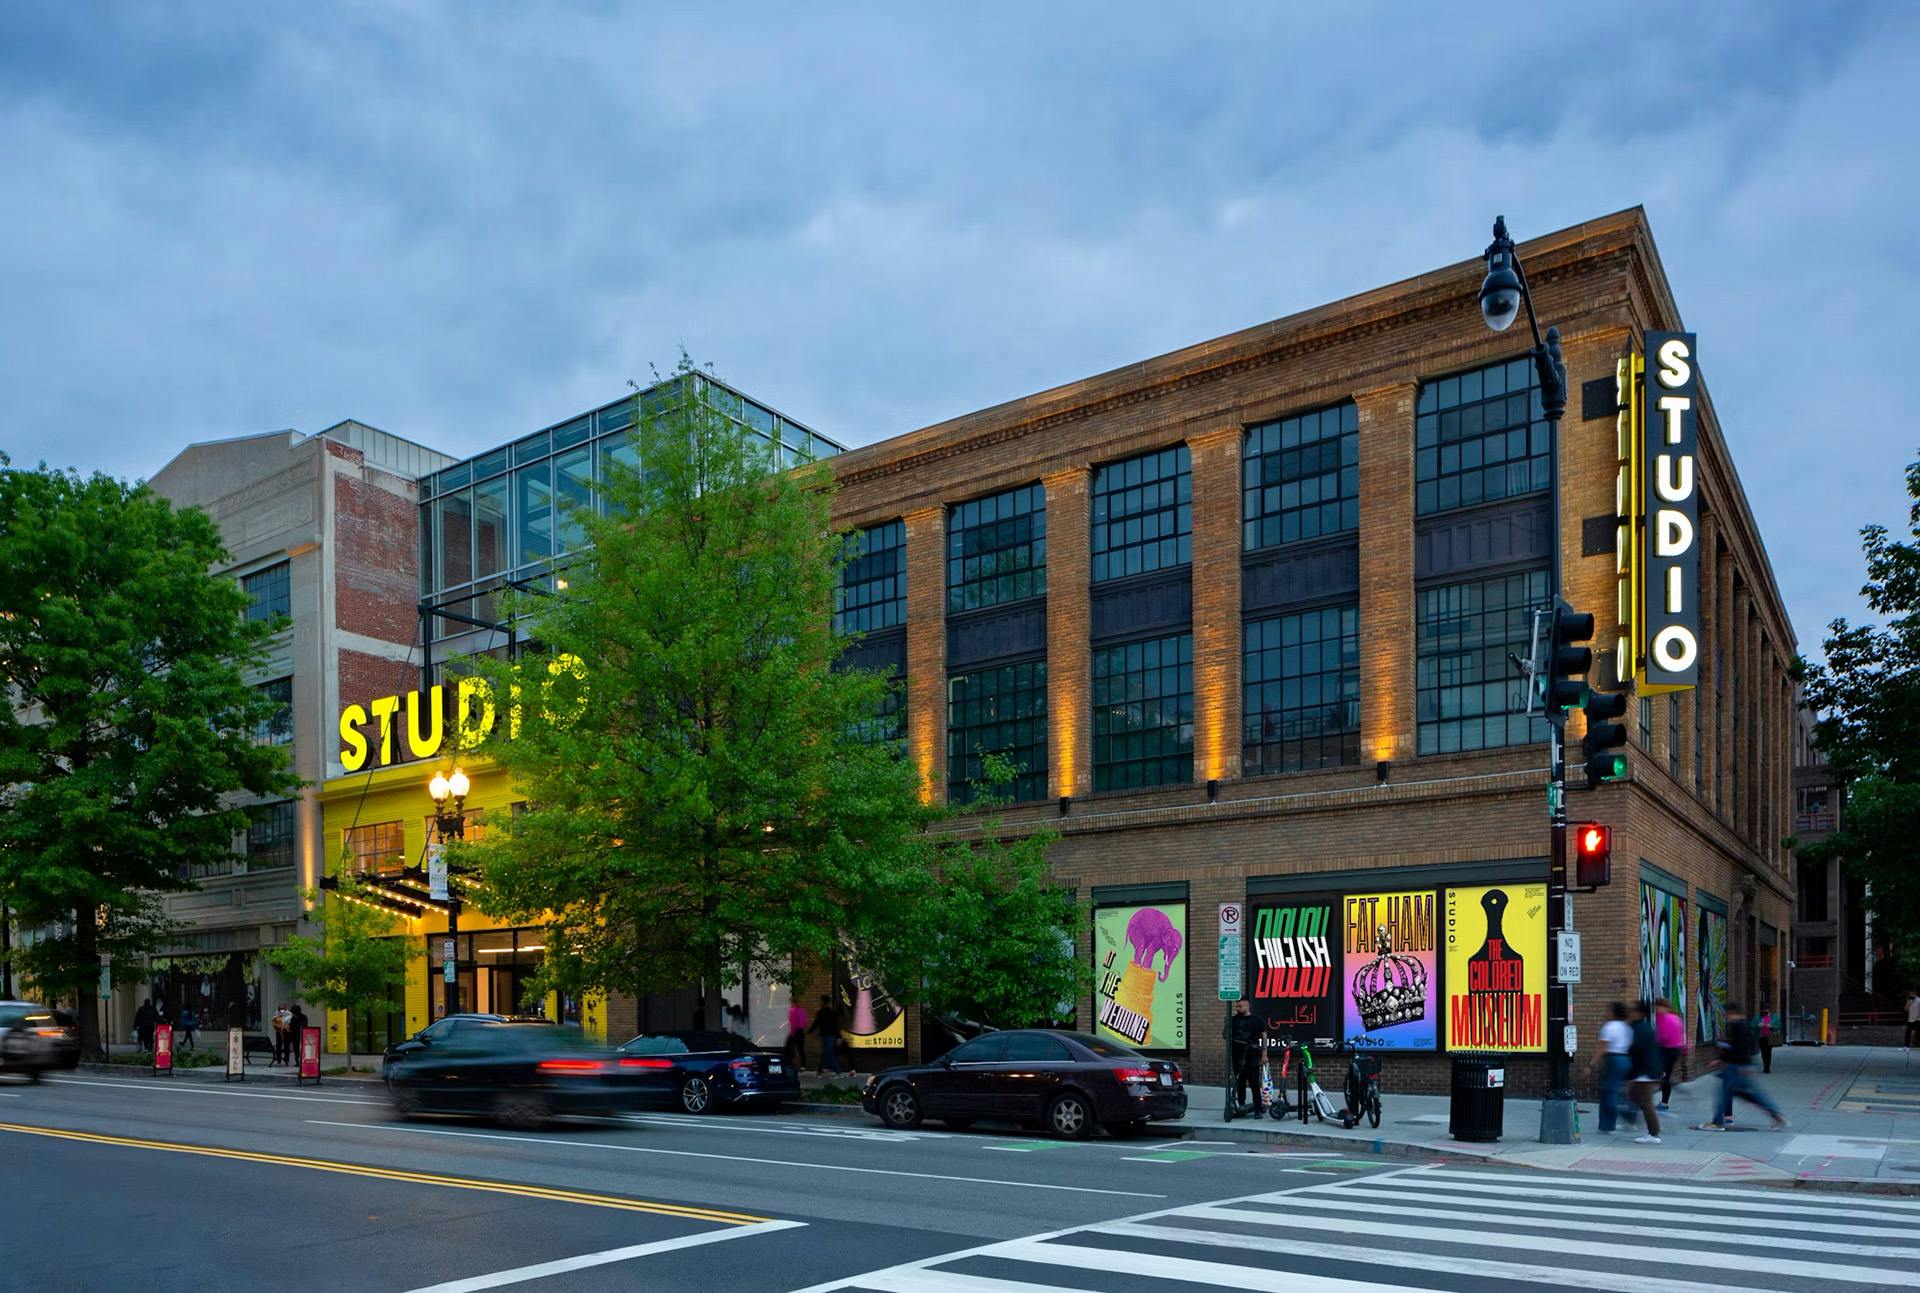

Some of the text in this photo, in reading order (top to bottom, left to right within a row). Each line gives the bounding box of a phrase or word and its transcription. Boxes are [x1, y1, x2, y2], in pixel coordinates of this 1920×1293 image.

[1651, 340, 1697, 673] STUDIO
[340, 653, 590, 772] STUDIO
[1346, 895, 1433, 953] FAT HAM
[1448, 891, 1456, 943] STUDIO
[1487, 939, 1503, 961] THE
[1562, 952, 1577, 962] TURN
[1564, 938, 1574, 949] NO
[1103, 949, 1116, 970] AT
[1560, 966, 1579, 977] ON RED
[1100, 970, 1121, 1000] THE
[1469, 960, 1522, 991] COLORED
[1099, 998, 1150, 1045] WEDDING
[1175, 992, 1183, 1039] STUDIO
[1451, 993, 1542, 1048] MUSEUM
[873, 1037, 903, 1045] STUDIO
[1257, 1037, 1288, 1047] TDIO
